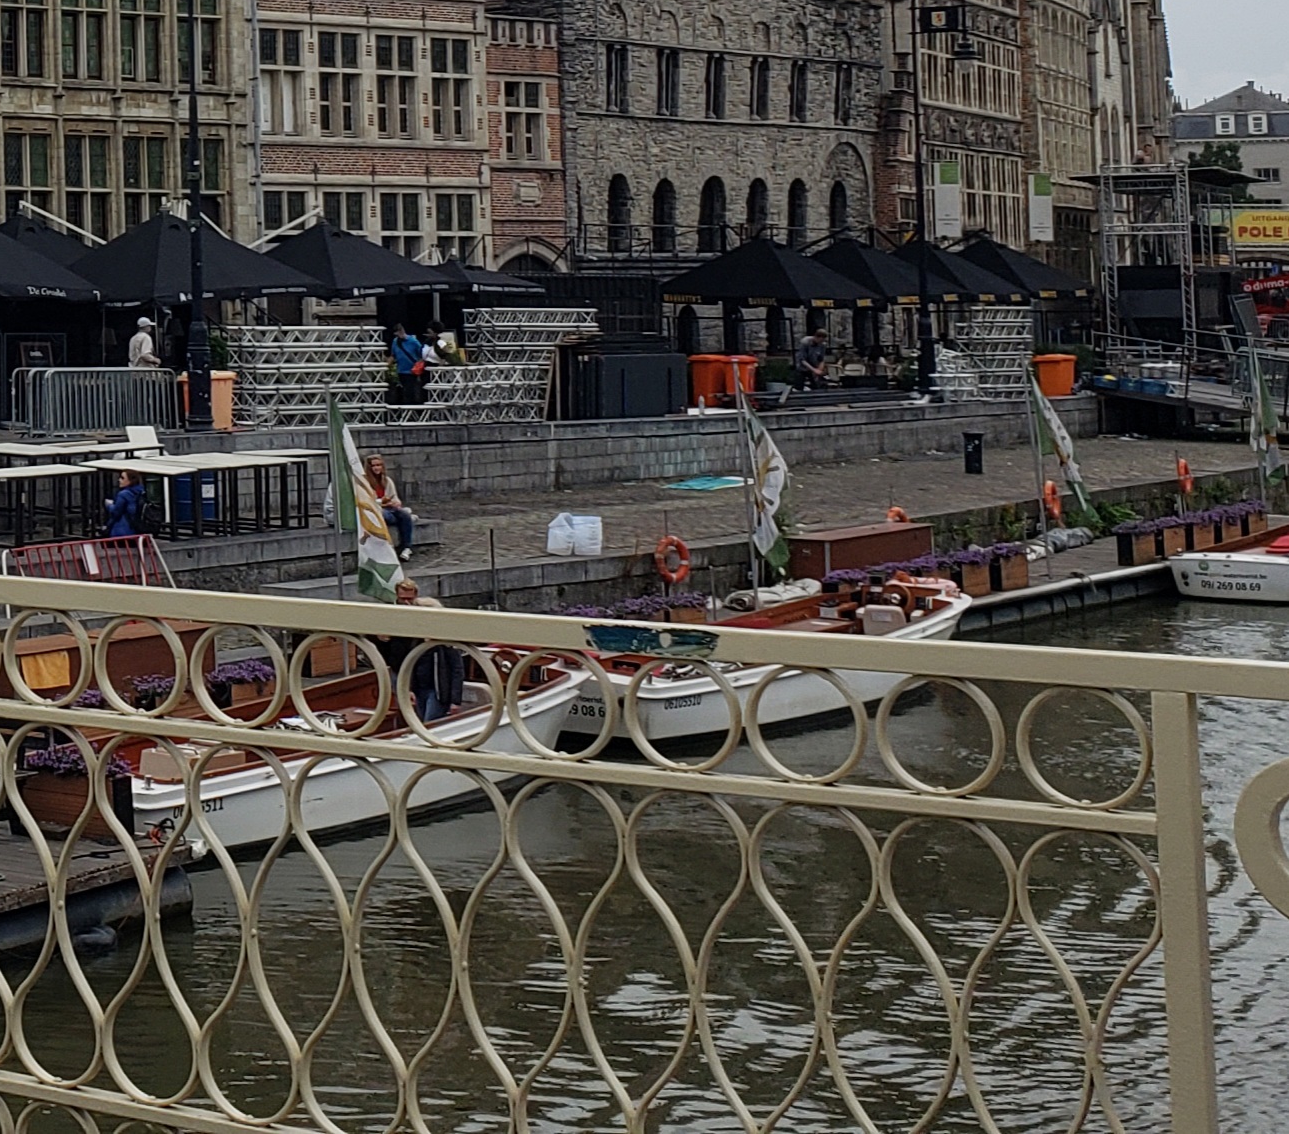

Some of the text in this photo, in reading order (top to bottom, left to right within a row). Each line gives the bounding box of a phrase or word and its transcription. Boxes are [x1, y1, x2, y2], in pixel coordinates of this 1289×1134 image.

[1238, 226, 1283, 237] POLE
[1217, 581, 1233, 590] 269
[1235, 582, 1247, 591] 08
[1249, 582, 1261, 592] 69
[664, 695, 701, 710] 06105510
[581, 705, 596, 717] 08
